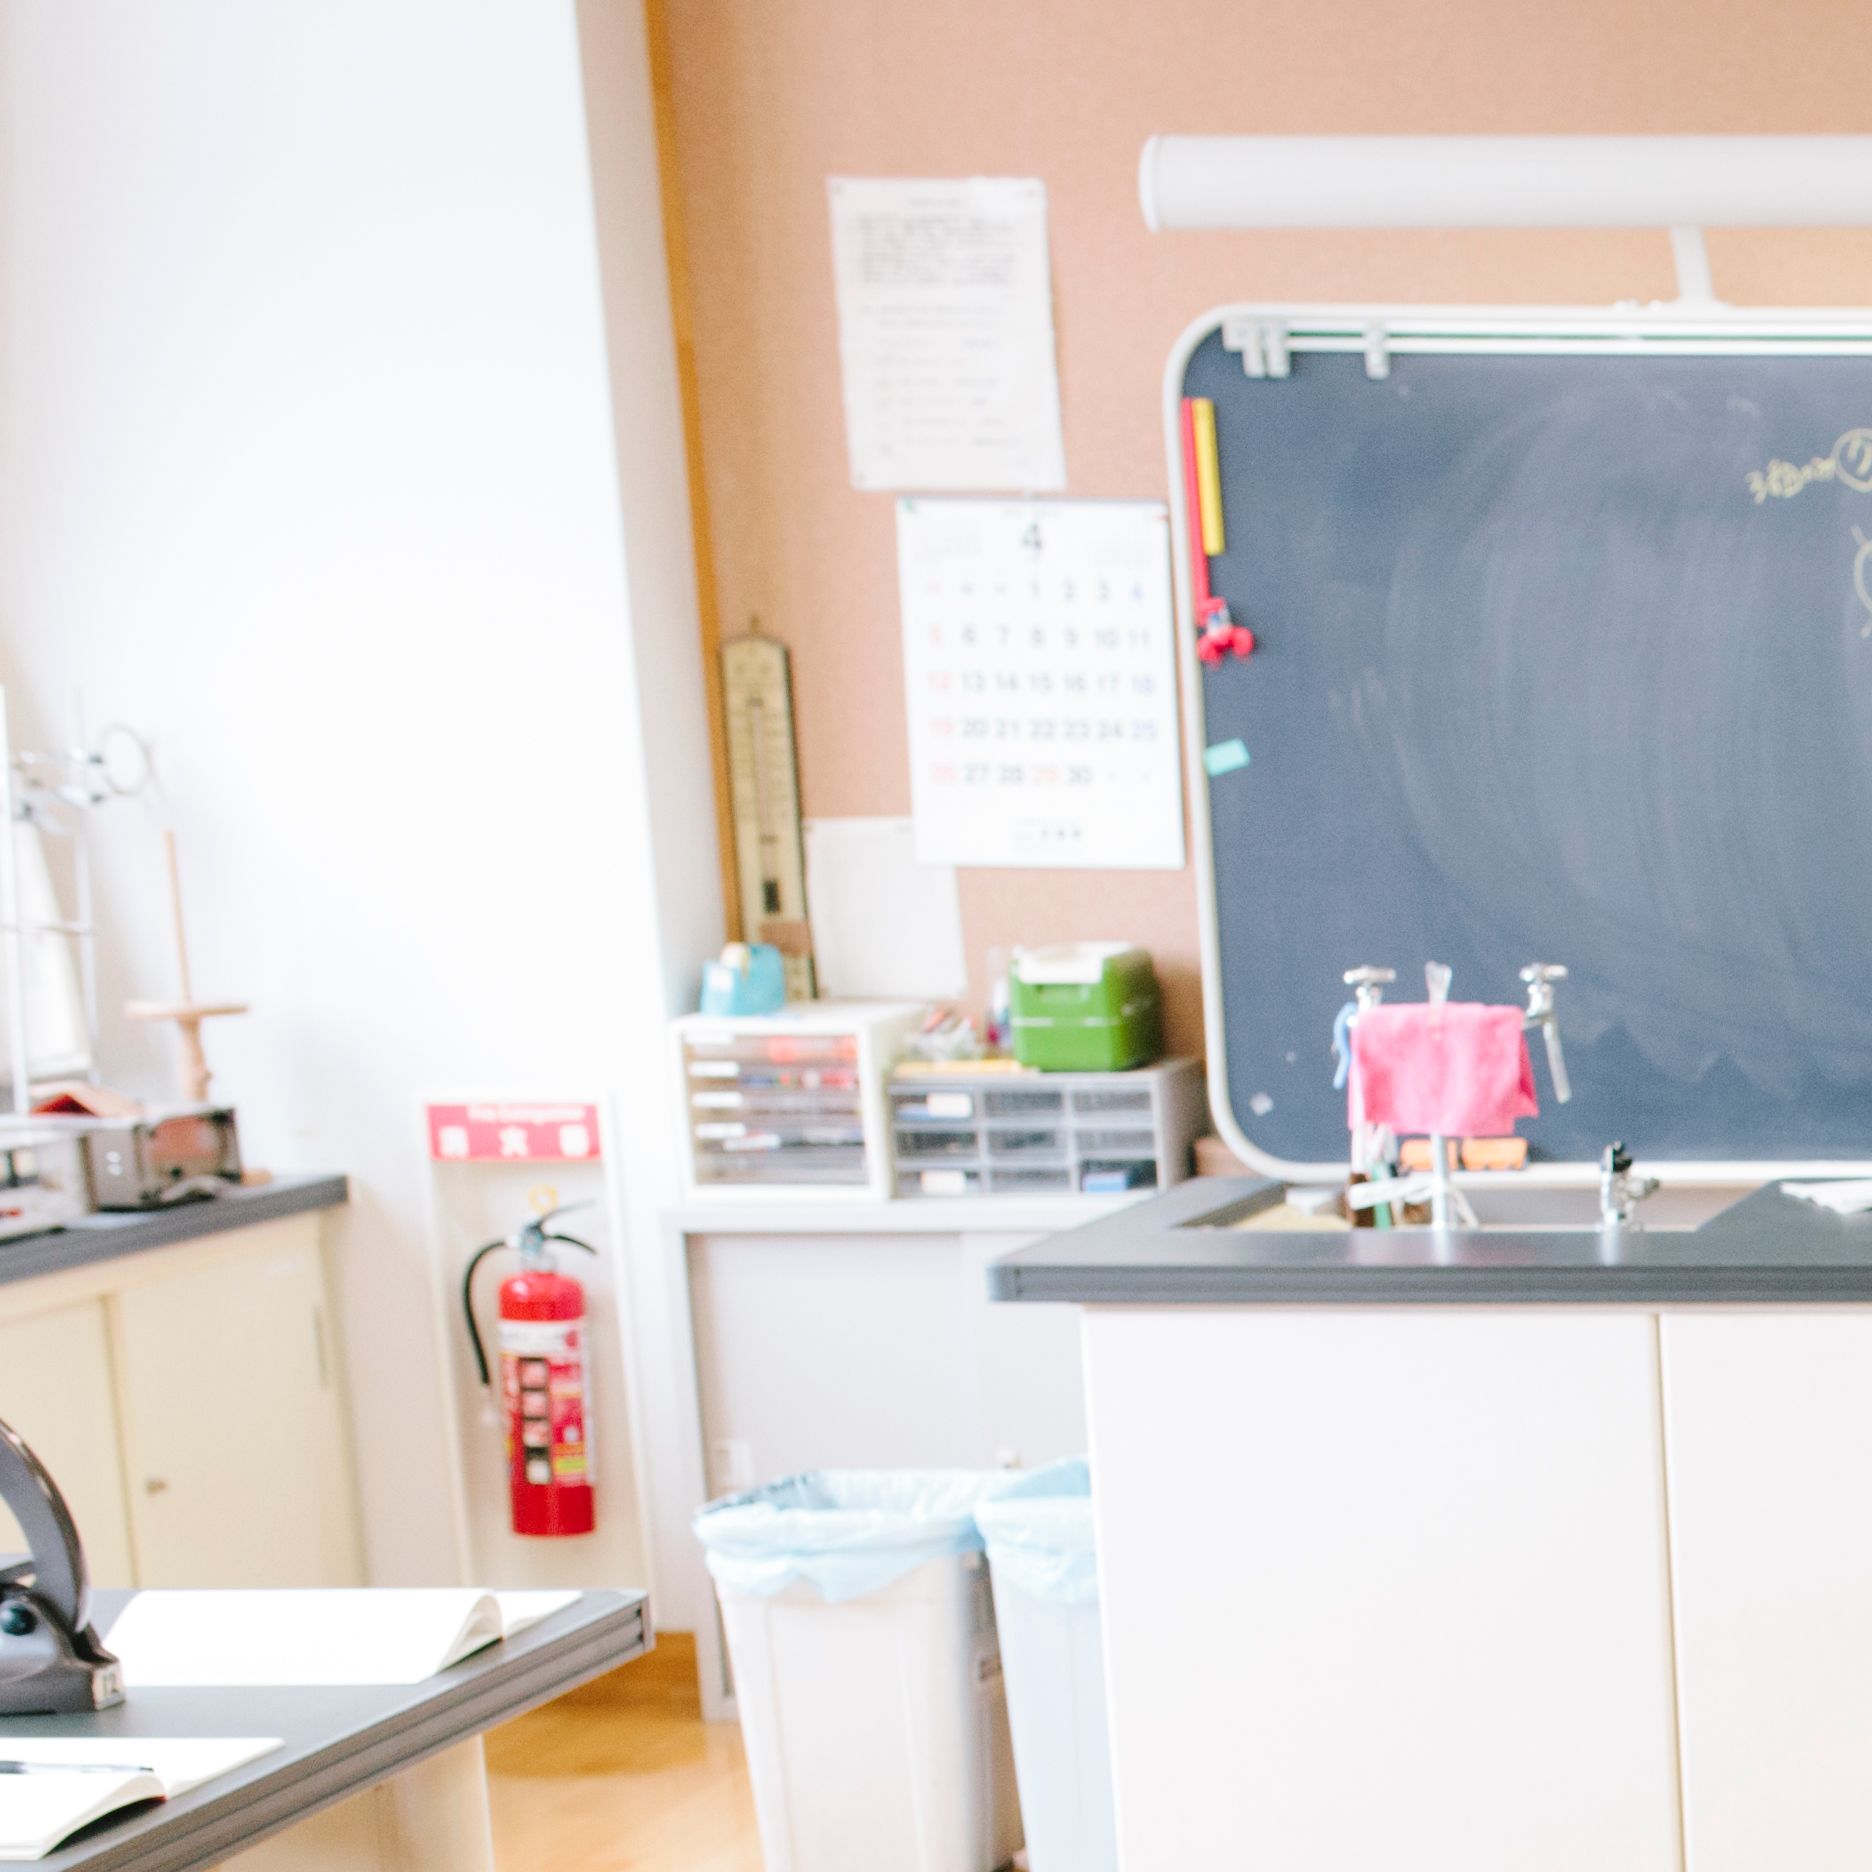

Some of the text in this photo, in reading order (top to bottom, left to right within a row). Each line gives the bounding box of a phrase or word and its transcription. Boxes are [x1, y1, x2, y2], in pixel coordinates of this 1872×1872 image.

[1021, 522, 1043, 551] 4
[961, 623, 976, 647] 6
[997, 623, 1010, 646] 7
[1031, 624, 1045, 648] 8
[1064, 624, 1078, 648] 9
[1095, 624, 1120, 648] 10
[1128, 625, 1151, 648] 11
[928, 670, 1155, 695] 12 13 14 15 16 17 18
[961, 716, 989, 740] 20
[995, 717, 1020, 740] 21
[1029, 717, 1056, 741] 22
[1063, 718, 1090, 741] 23
[1097, 719, 1123, 740] 24
[1130, 719, 1158, 742] 25
[962, 762, 991, 785] 27
[996, 763, 1025, 786] 28
[1065, 763, 1093, 786] 30
